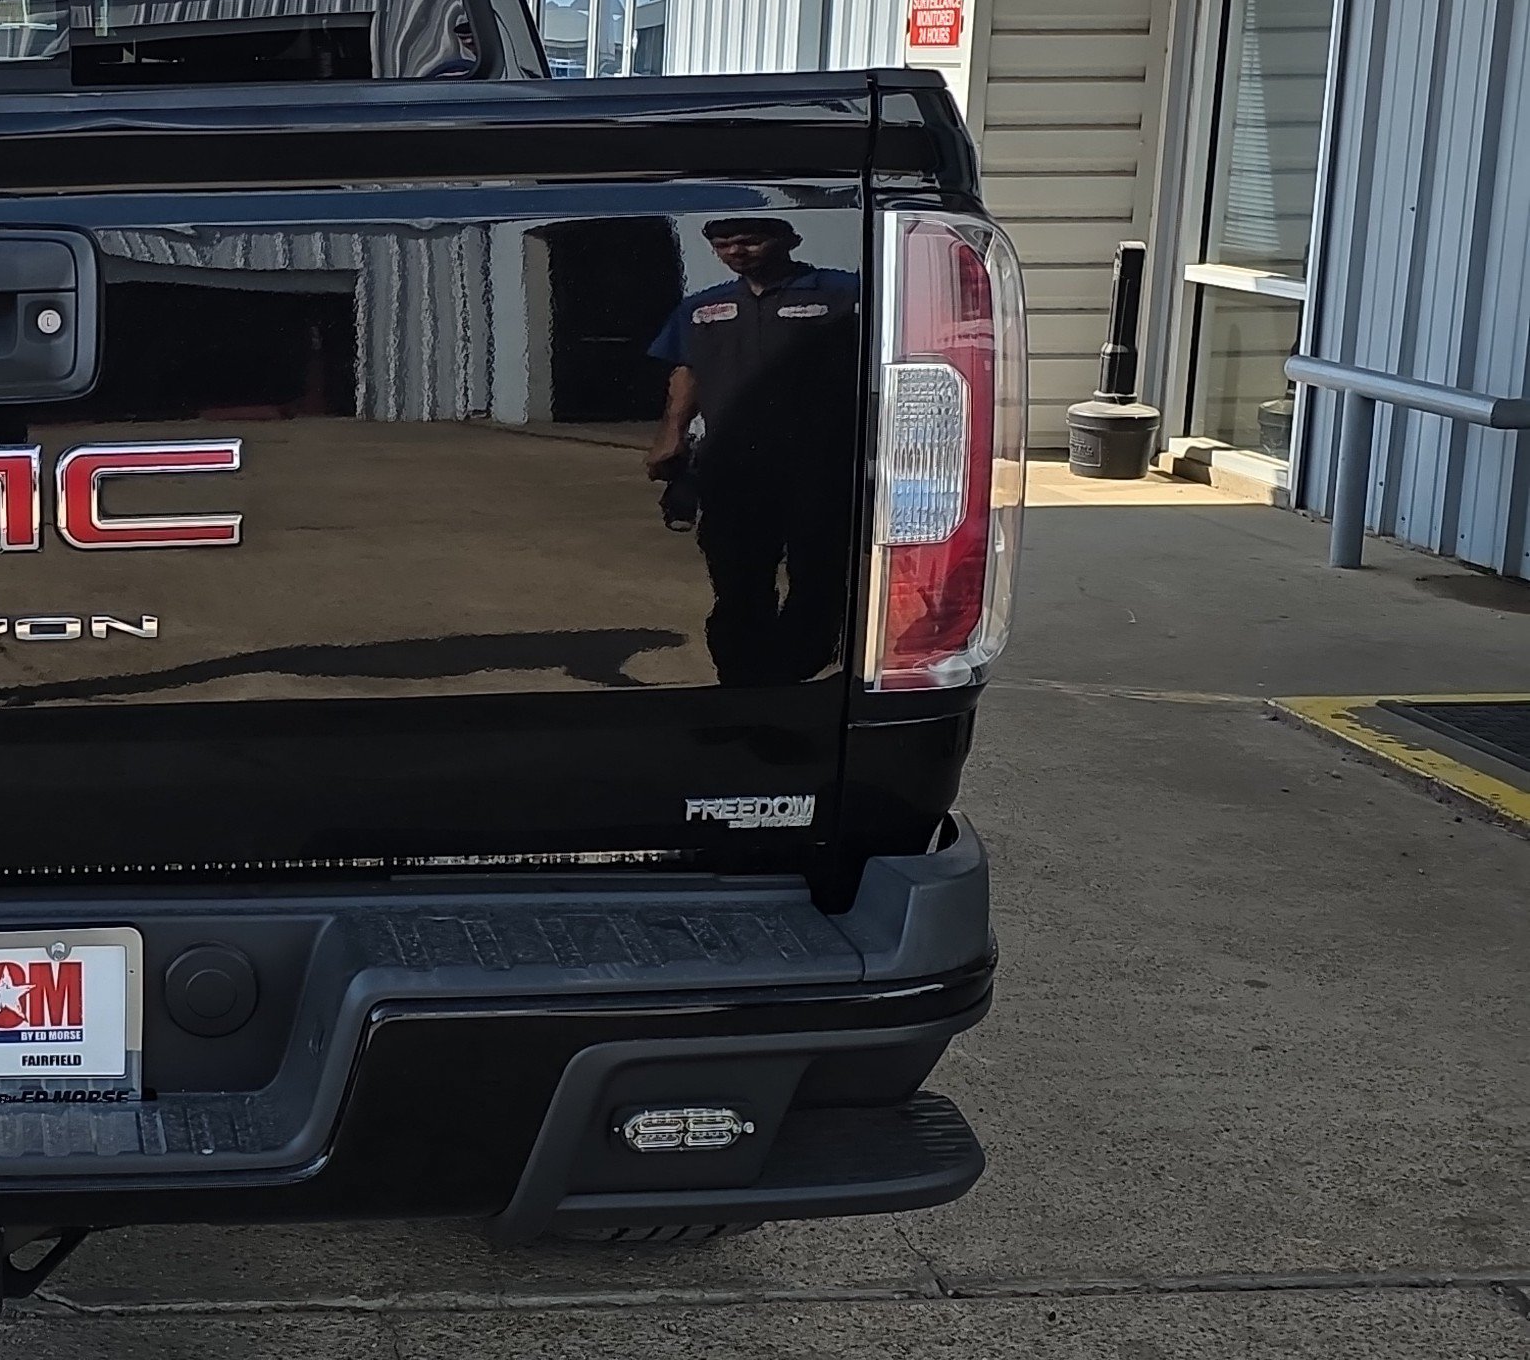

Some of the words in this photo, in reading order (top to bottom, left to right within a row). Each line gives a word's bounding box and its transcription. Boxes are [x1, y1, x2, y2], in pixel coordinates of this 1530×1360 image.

[685, 794, 816, 821] FREEDOM
[21, 1031, 33, 1041] BY
[35, 1031, 47, 1040] ED
[49, 1030, 82, 1040] MORSE
[21, 1054, 82, 1067] FAIRFIELD
